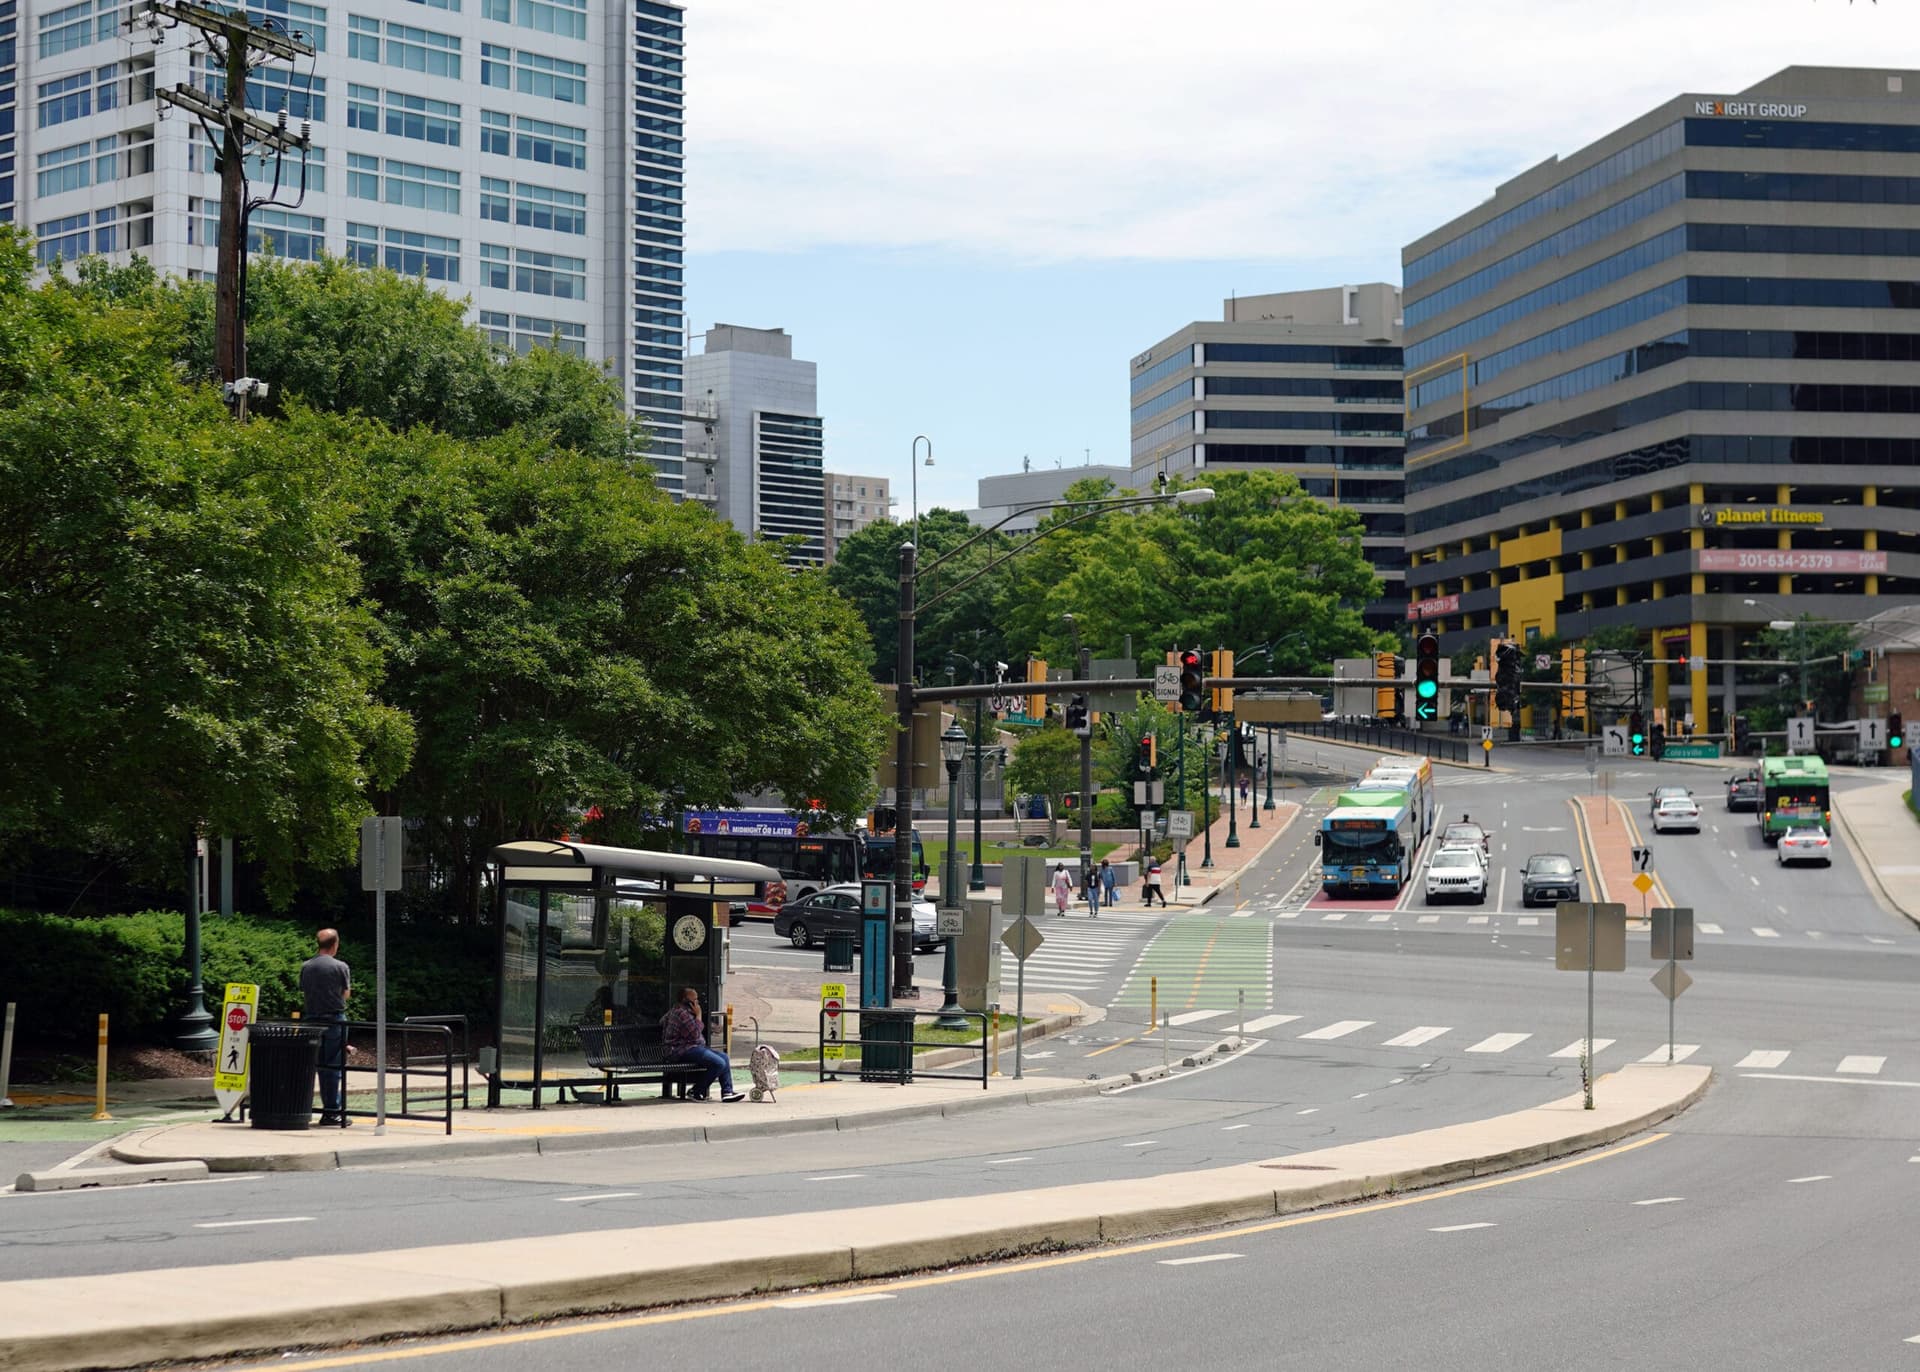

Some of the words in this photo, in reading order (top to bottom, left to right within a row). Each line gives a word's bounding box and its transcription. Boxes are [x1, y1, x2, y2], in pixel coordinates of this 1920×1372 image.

[1695, 101, 1756, 116] NEXIGHT
[1759, 103, 1807, 117] GROUP
[1716, 508, 1767, 526] planet
[1771, 508, 1824, 523] fitness
[1739, 553, 1833, 568] 301-634-2379
[1664, 748, 1703, 757] Colesville
[732, 826, 761, 834] MIDNIGHT
[228, 1014, 248, 1025] STOP
